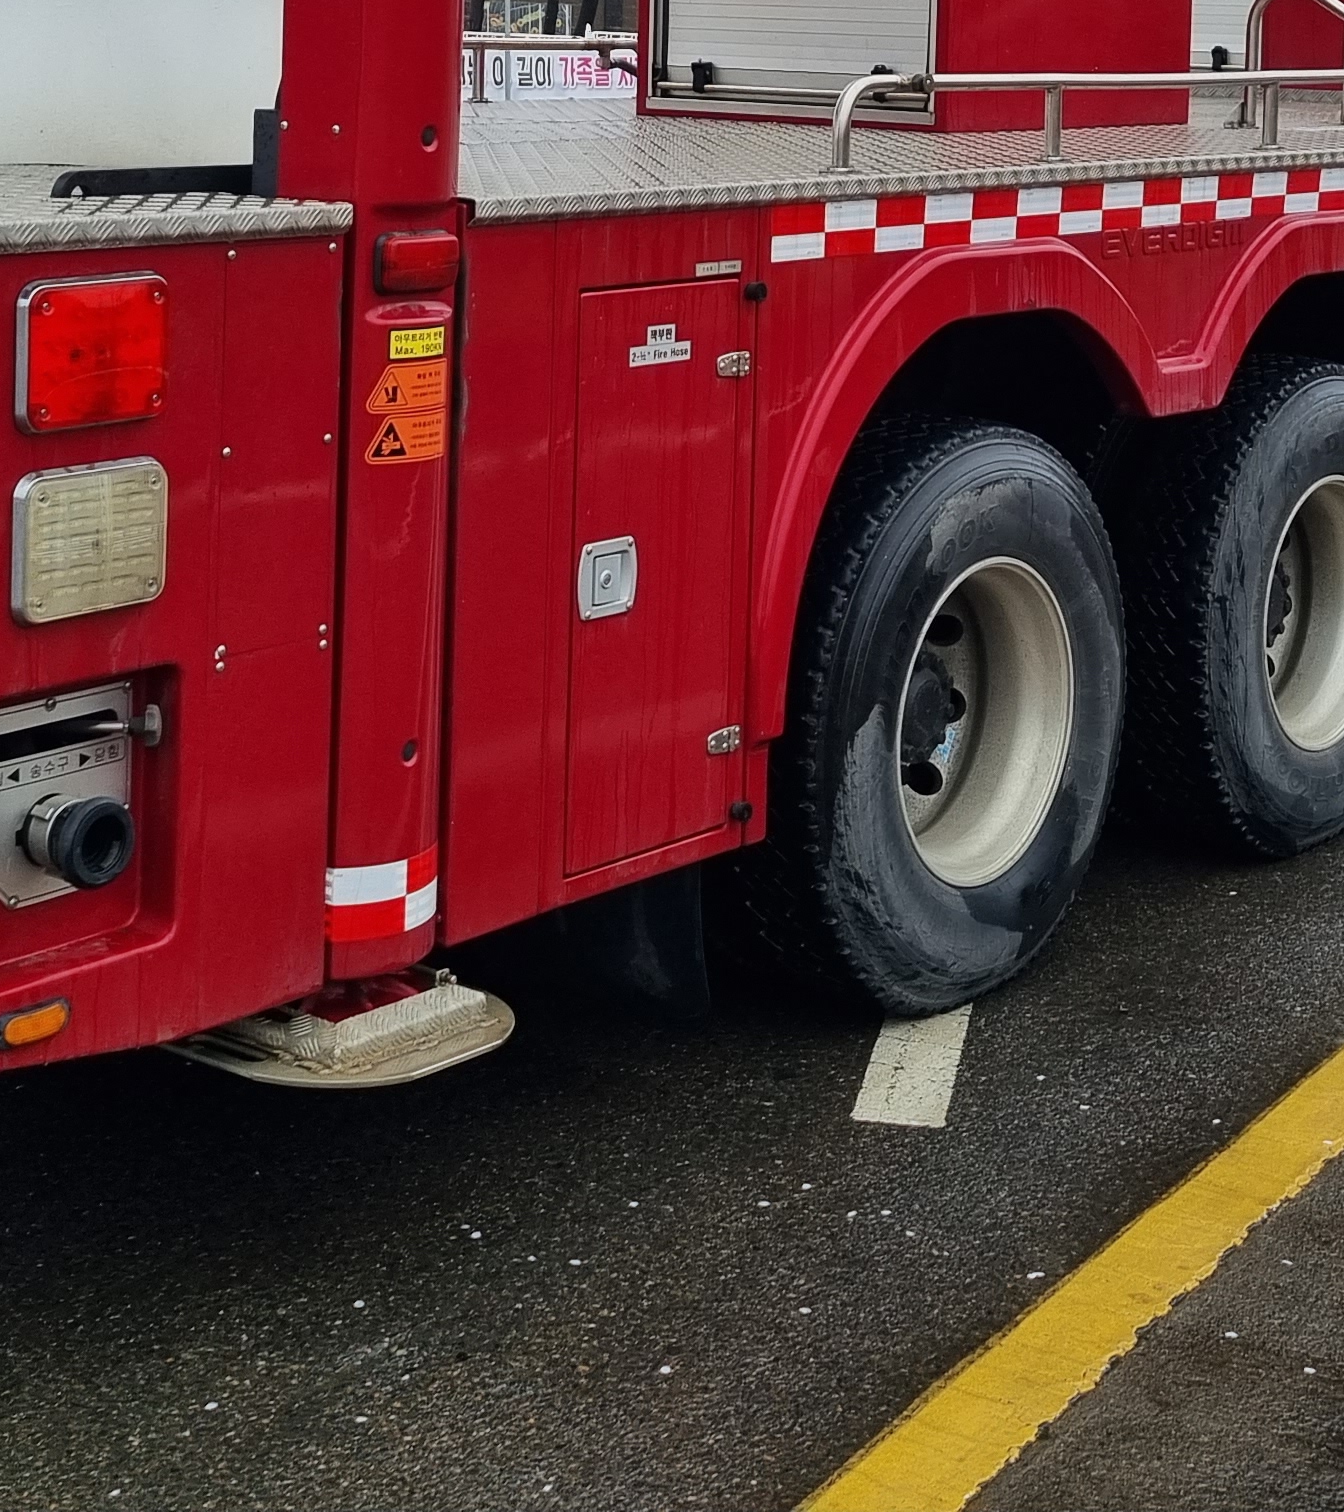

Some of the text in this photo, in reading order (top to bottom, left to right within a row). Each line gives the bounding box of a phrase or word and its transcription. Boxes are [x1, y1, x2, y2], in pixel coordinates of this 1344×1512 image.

[516, 55, 552, 88] 길이
[653, 349, 668, 360] Fire
[670, 347, 689, 357] Hose
[30, 756, 69, 779] 송수구
